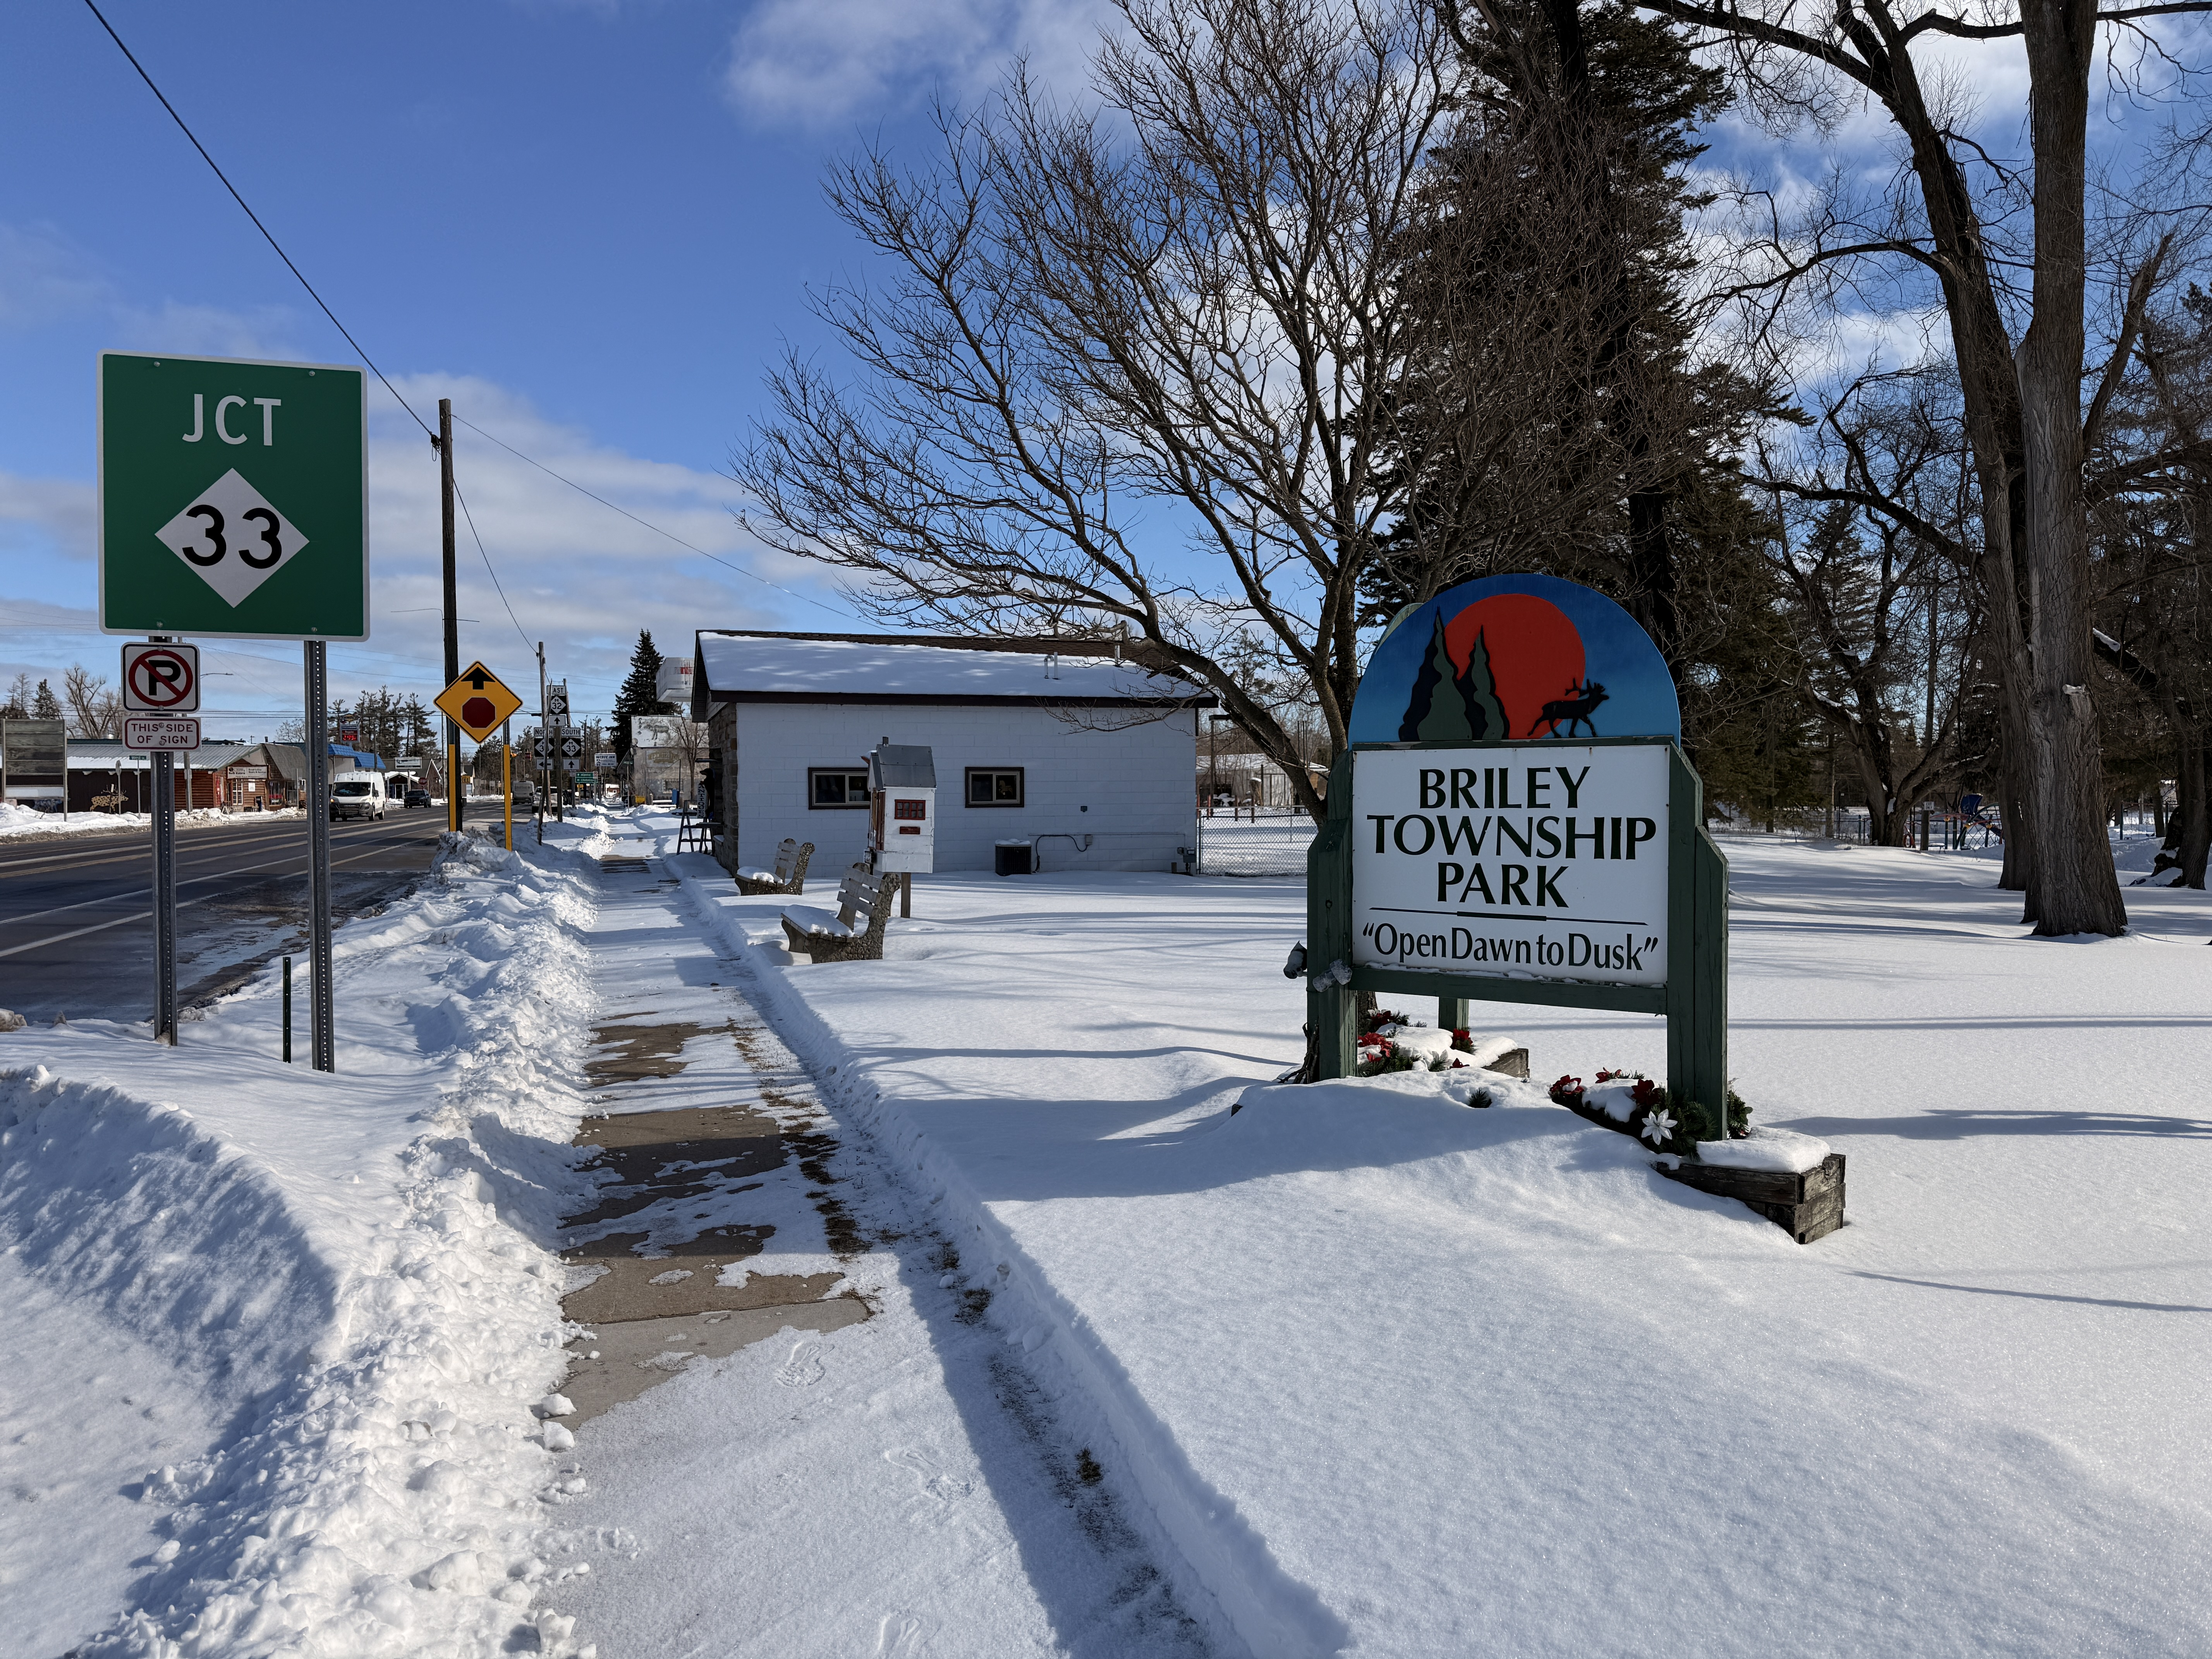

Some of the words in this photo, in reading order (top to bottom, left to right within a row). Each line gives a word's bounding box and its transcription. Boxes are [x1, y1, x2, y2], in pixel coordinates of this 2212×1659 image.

[182, 393, 282, 446] JCT
[182, 504, 282, 569] 33
[131, 723, 159, 732] THIS
[166, 724, 193, 732] SIDE
[137, 735, 153, 744] OF
[160, 735, 187, 744] SIGN
[1419, 766, 1591, 809] BRILEY
[1367, 814, 1657, 860] TOWNSHIP
[1437, 862, 1569, 908] PARK
[1451, 927, 1531, 964] Dawn
[1536, 935, 1565, 967] to
